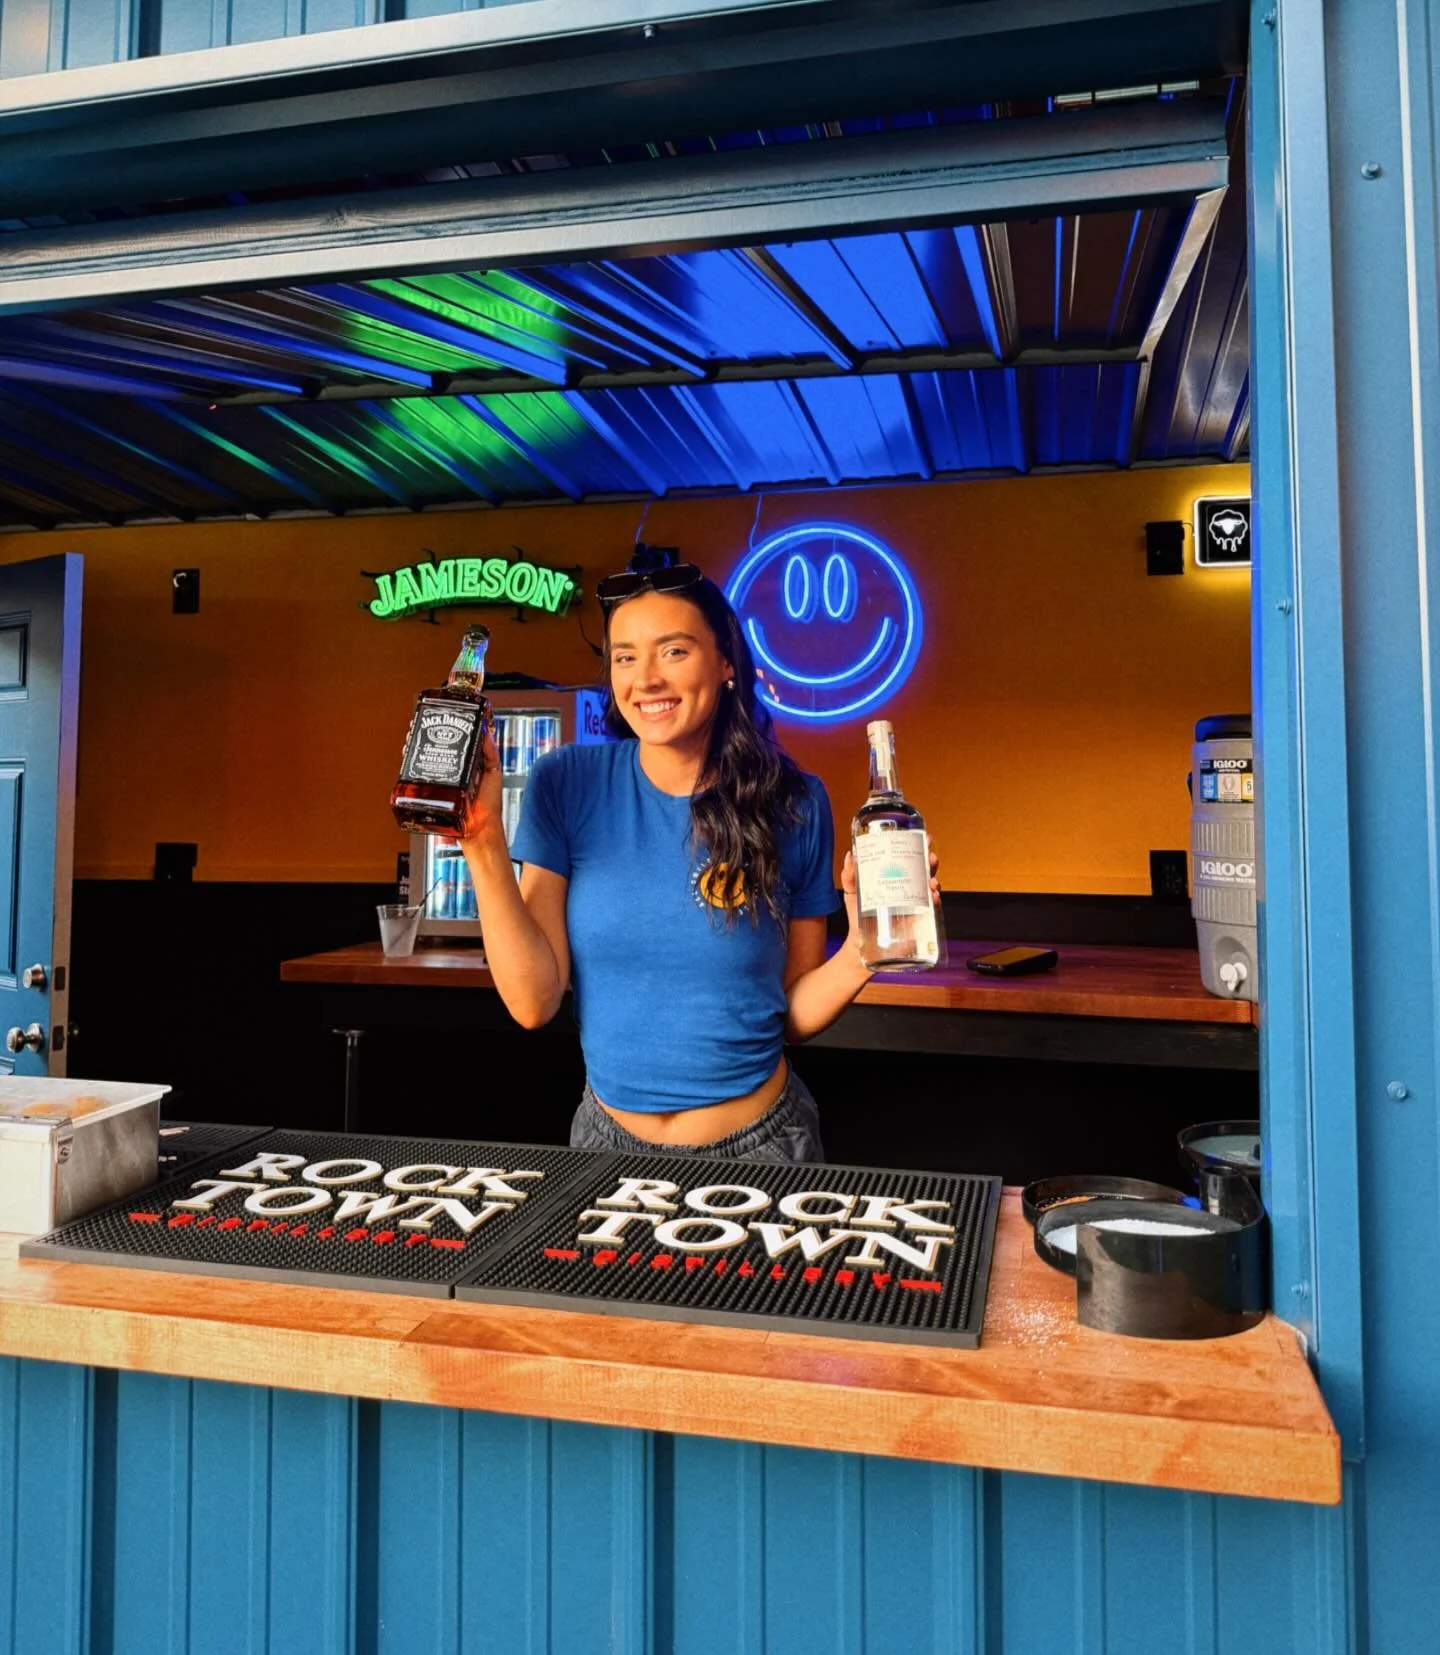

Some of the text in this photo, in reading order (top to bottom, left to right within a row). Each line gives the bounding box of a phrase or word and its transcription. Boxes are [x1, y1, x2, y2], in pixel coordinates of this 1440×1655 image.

[369, 557, 570, 617] JAMESON
[421, 715, 442, 729] JACK
[1213, 760, 1248, 769] IGLOO
[1200, 861, 1253, 877] IGLOO
[220, 1152, 545, 1200] ROCK
[172, 1179, 516, 1234] TOWN
[596, 1177, 956, 1232] ROCK
[577, 1209, 956, 1272] TOWN
